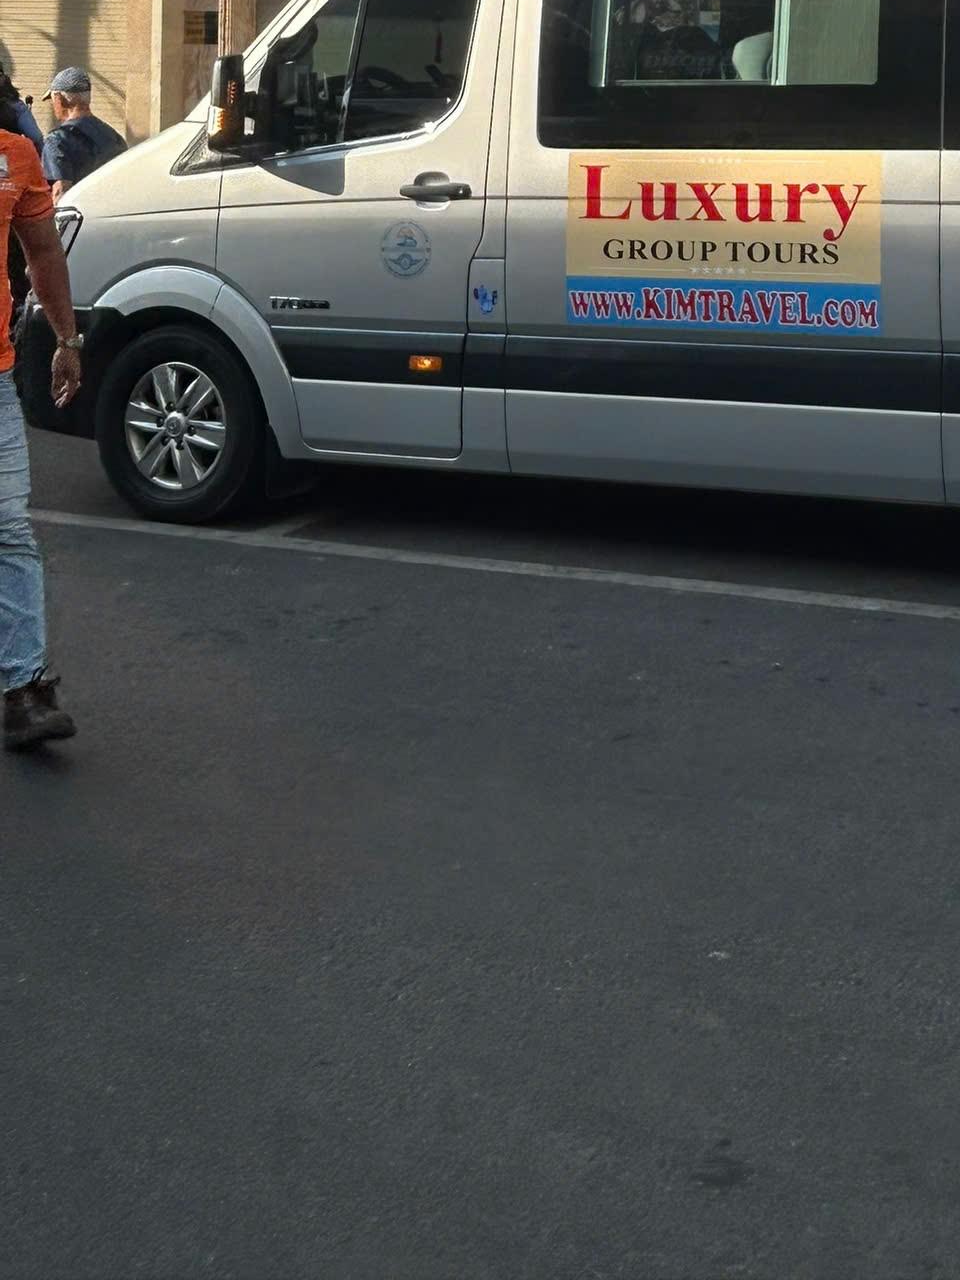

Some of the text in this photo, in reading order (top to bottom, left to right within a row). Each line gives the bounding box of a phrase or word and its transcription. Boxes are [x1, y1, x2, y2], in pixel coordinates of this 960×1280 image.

[578, 164, 868, 242] Luxury
[603, 238, 840, 265] GROUP TOURS
